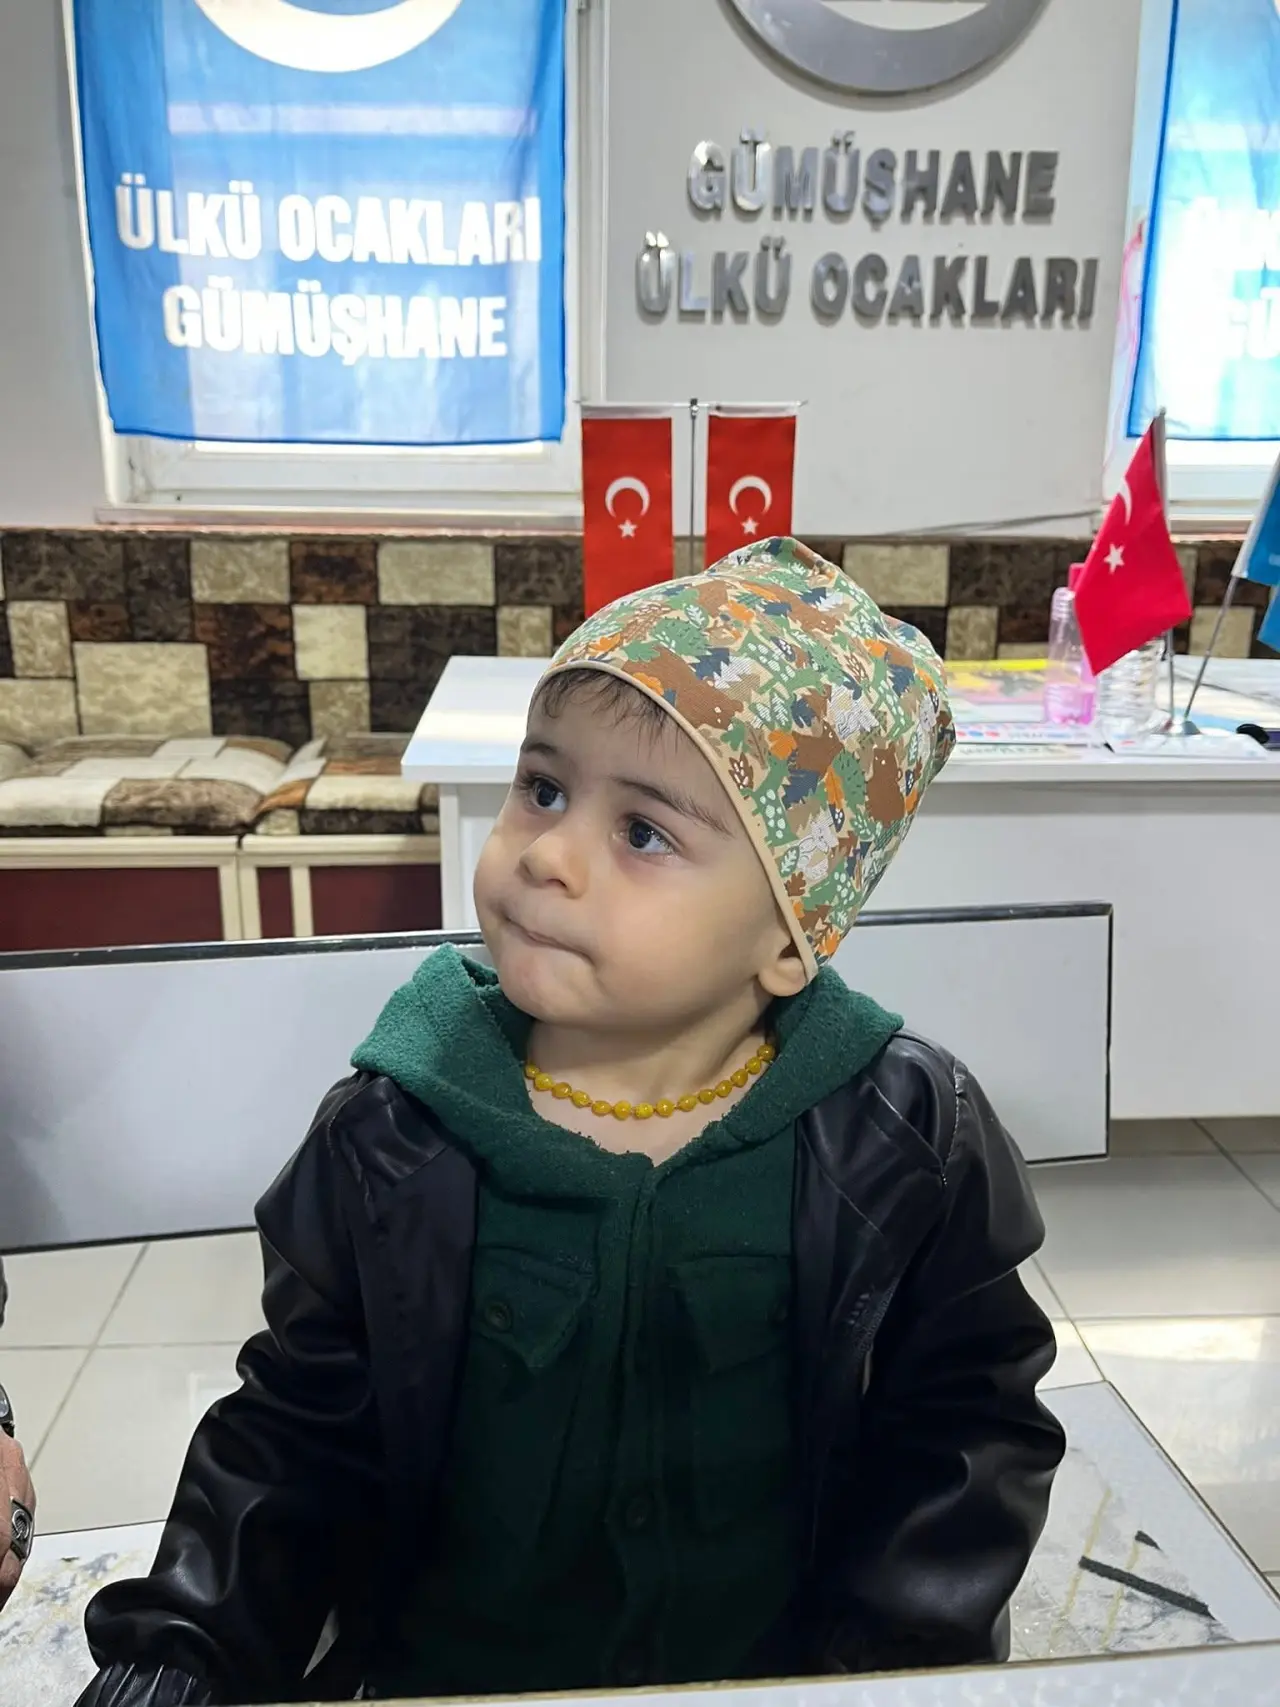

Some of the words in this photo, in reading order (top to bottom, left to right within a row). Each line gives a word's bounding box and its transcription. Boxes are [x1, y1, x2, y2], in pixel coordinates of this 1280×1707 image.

[115, 172, 262, 260] ÜLKÜ
[278, 194, 541, 266] OCAKLARI
[687, 125, 1059, 222] GÜMÜŞHANE
[163, 275, 507, 366] GÜMÜŞHANE
[635, 231, 792, 318] ÜLKÜ
[810, 252, 1098, 323] OCAKLARI
